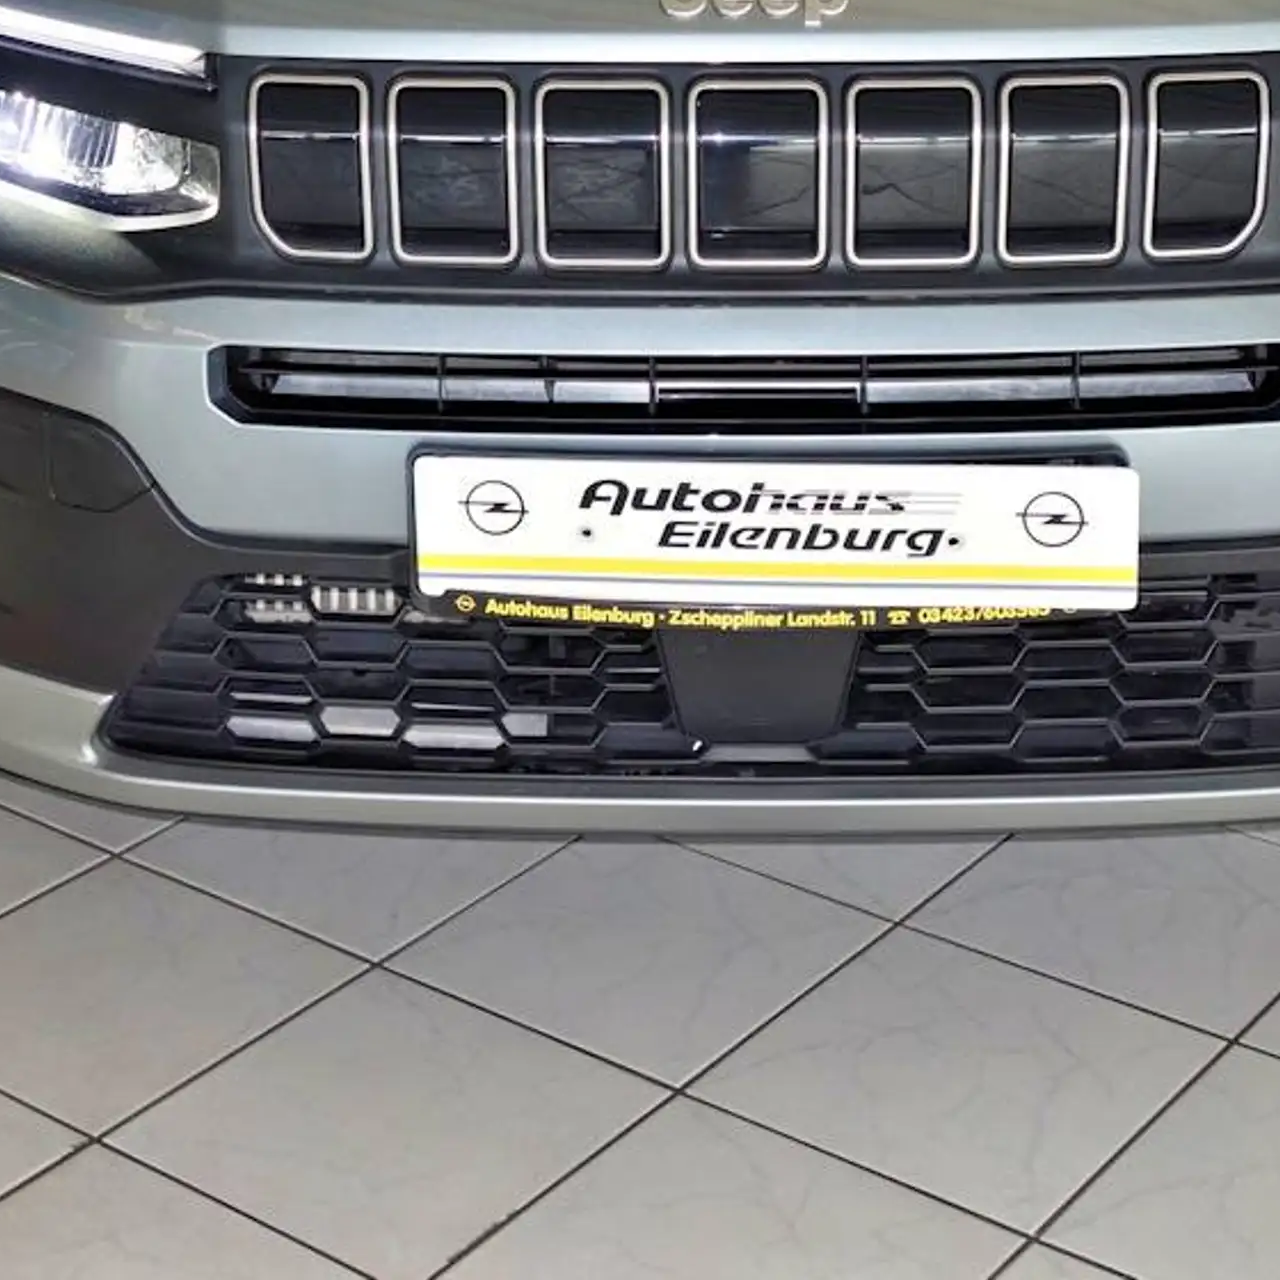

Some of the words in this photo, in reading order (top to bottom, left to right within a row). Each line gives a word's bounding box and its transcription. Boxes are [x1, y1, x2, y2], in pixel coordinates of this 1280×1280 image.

[579, 479, 912, 516] Autohaus
[658, 521, 946, 558] Eilenburg
[484, 598, 570, 620] Autohaus
[572, 603, 655, 628] Eilenburg
[668, 608, 784, 631] Zscheppliner
[788, 609, 856, 628] Landstr.
[860, 609, 875, 626] 11
